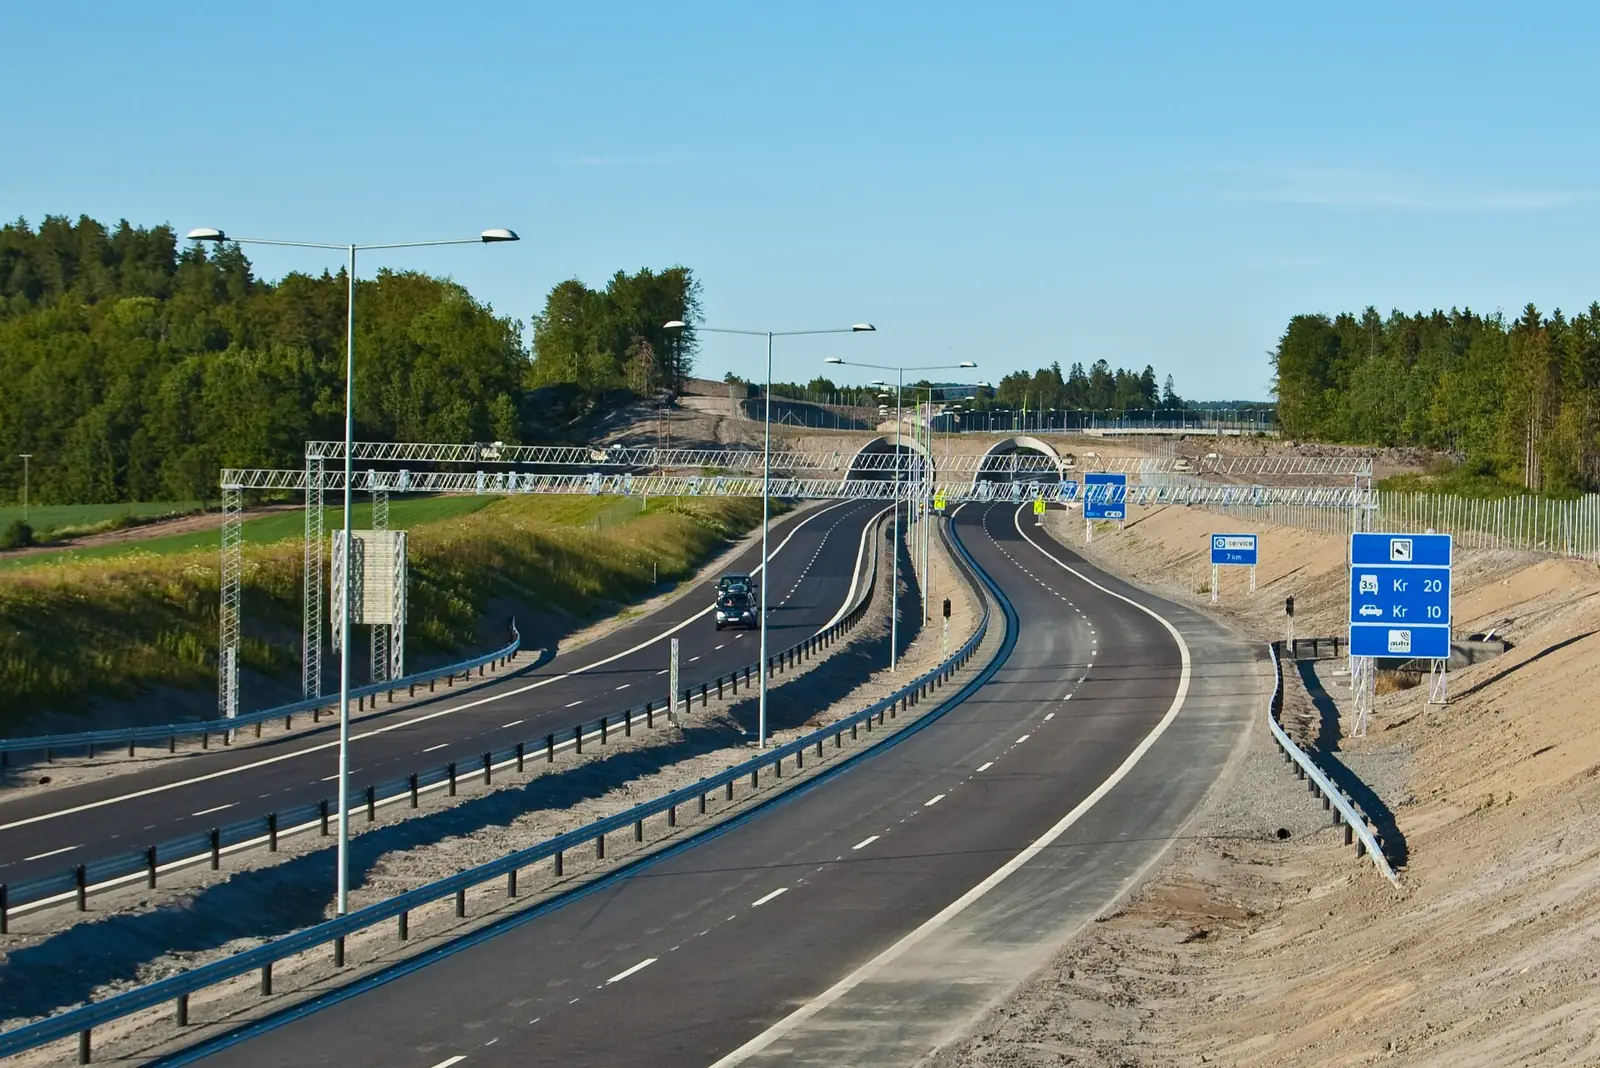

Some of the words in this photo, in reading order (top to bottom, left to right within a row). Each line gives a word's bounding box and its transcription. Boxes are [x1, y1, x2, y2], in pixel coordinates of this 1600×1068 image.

[1393, 579, 1408, 592] Kr
[1423, 579, 1442, 592] 20
[1392, 605, 1408, 617] Kr
[1427, 606, 1441, 618] 10
